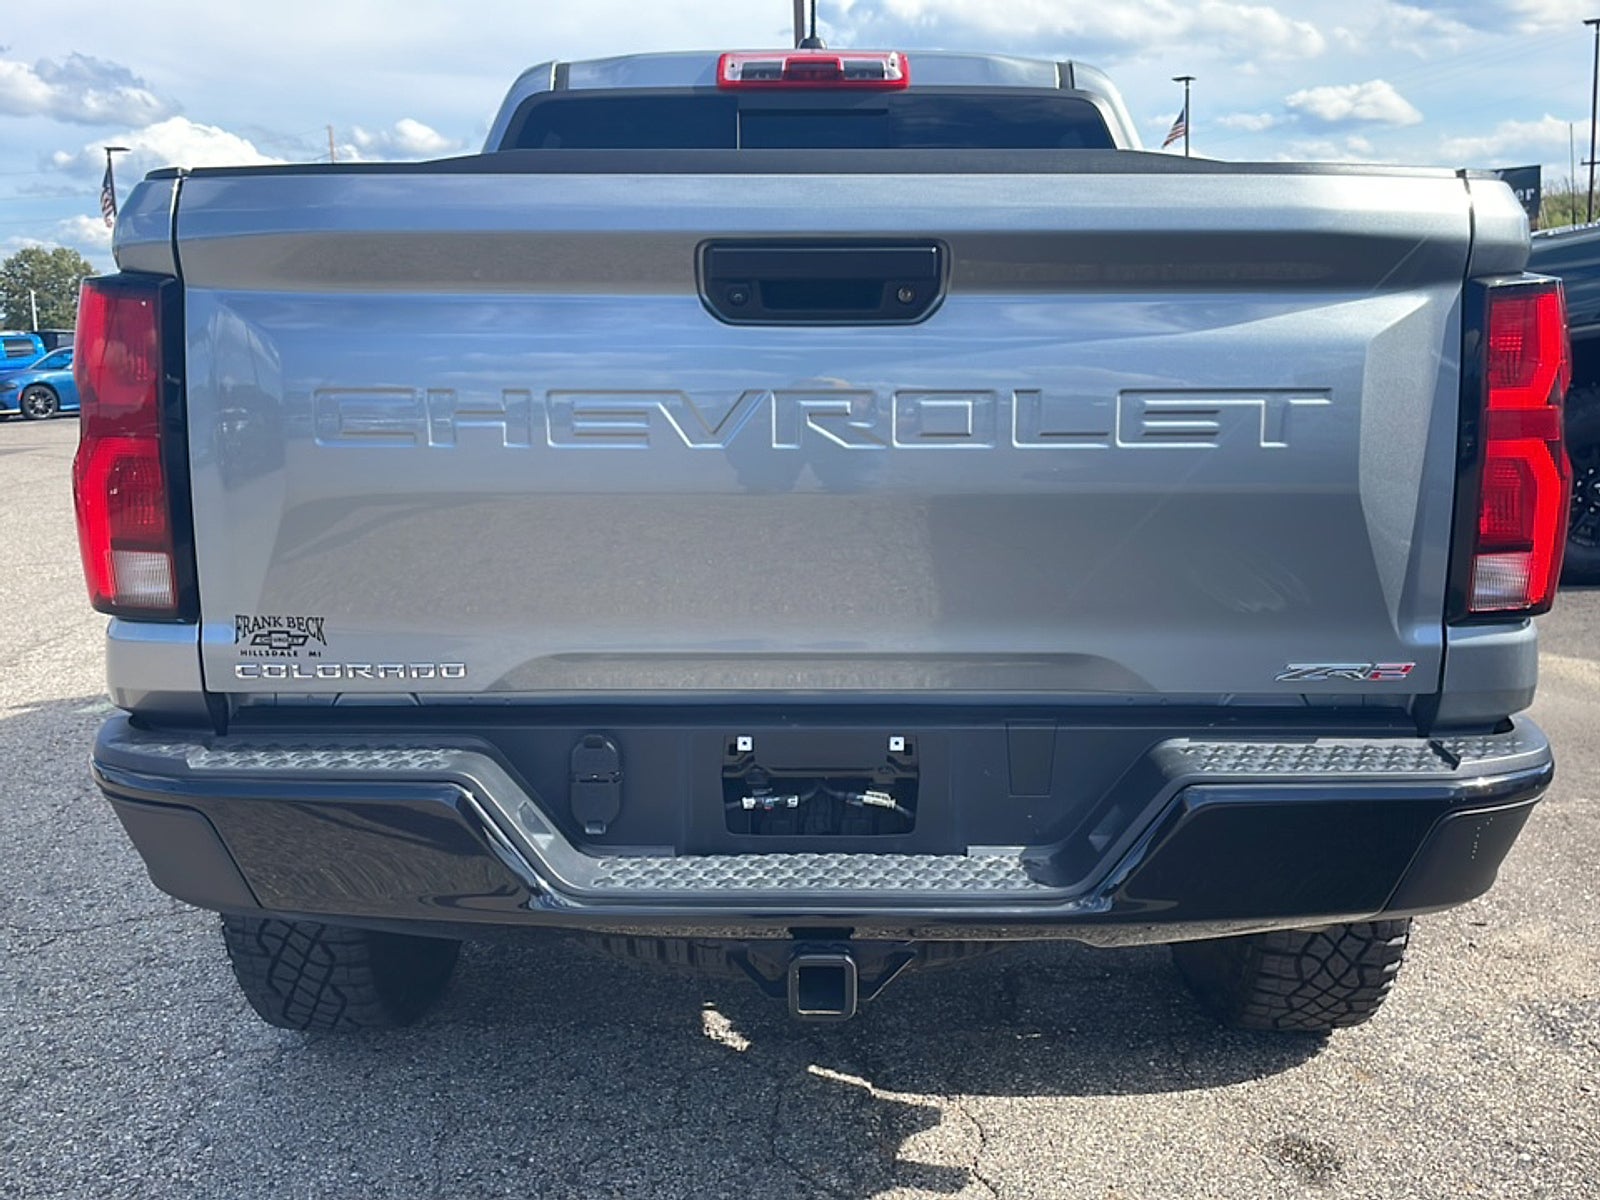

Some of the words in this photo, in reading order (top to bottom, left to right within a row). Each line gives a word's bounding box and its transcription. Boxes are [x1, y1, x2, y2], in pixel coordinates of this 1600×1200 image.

[312, 388, 1333, 449] CHEVROLET
[234, 615, 283, 644] FRANK
[286, 616, 327, 646] BECK
[234, 664, 466, 678] COLORADO
[1275, 662, 1416, 681] ZR2
